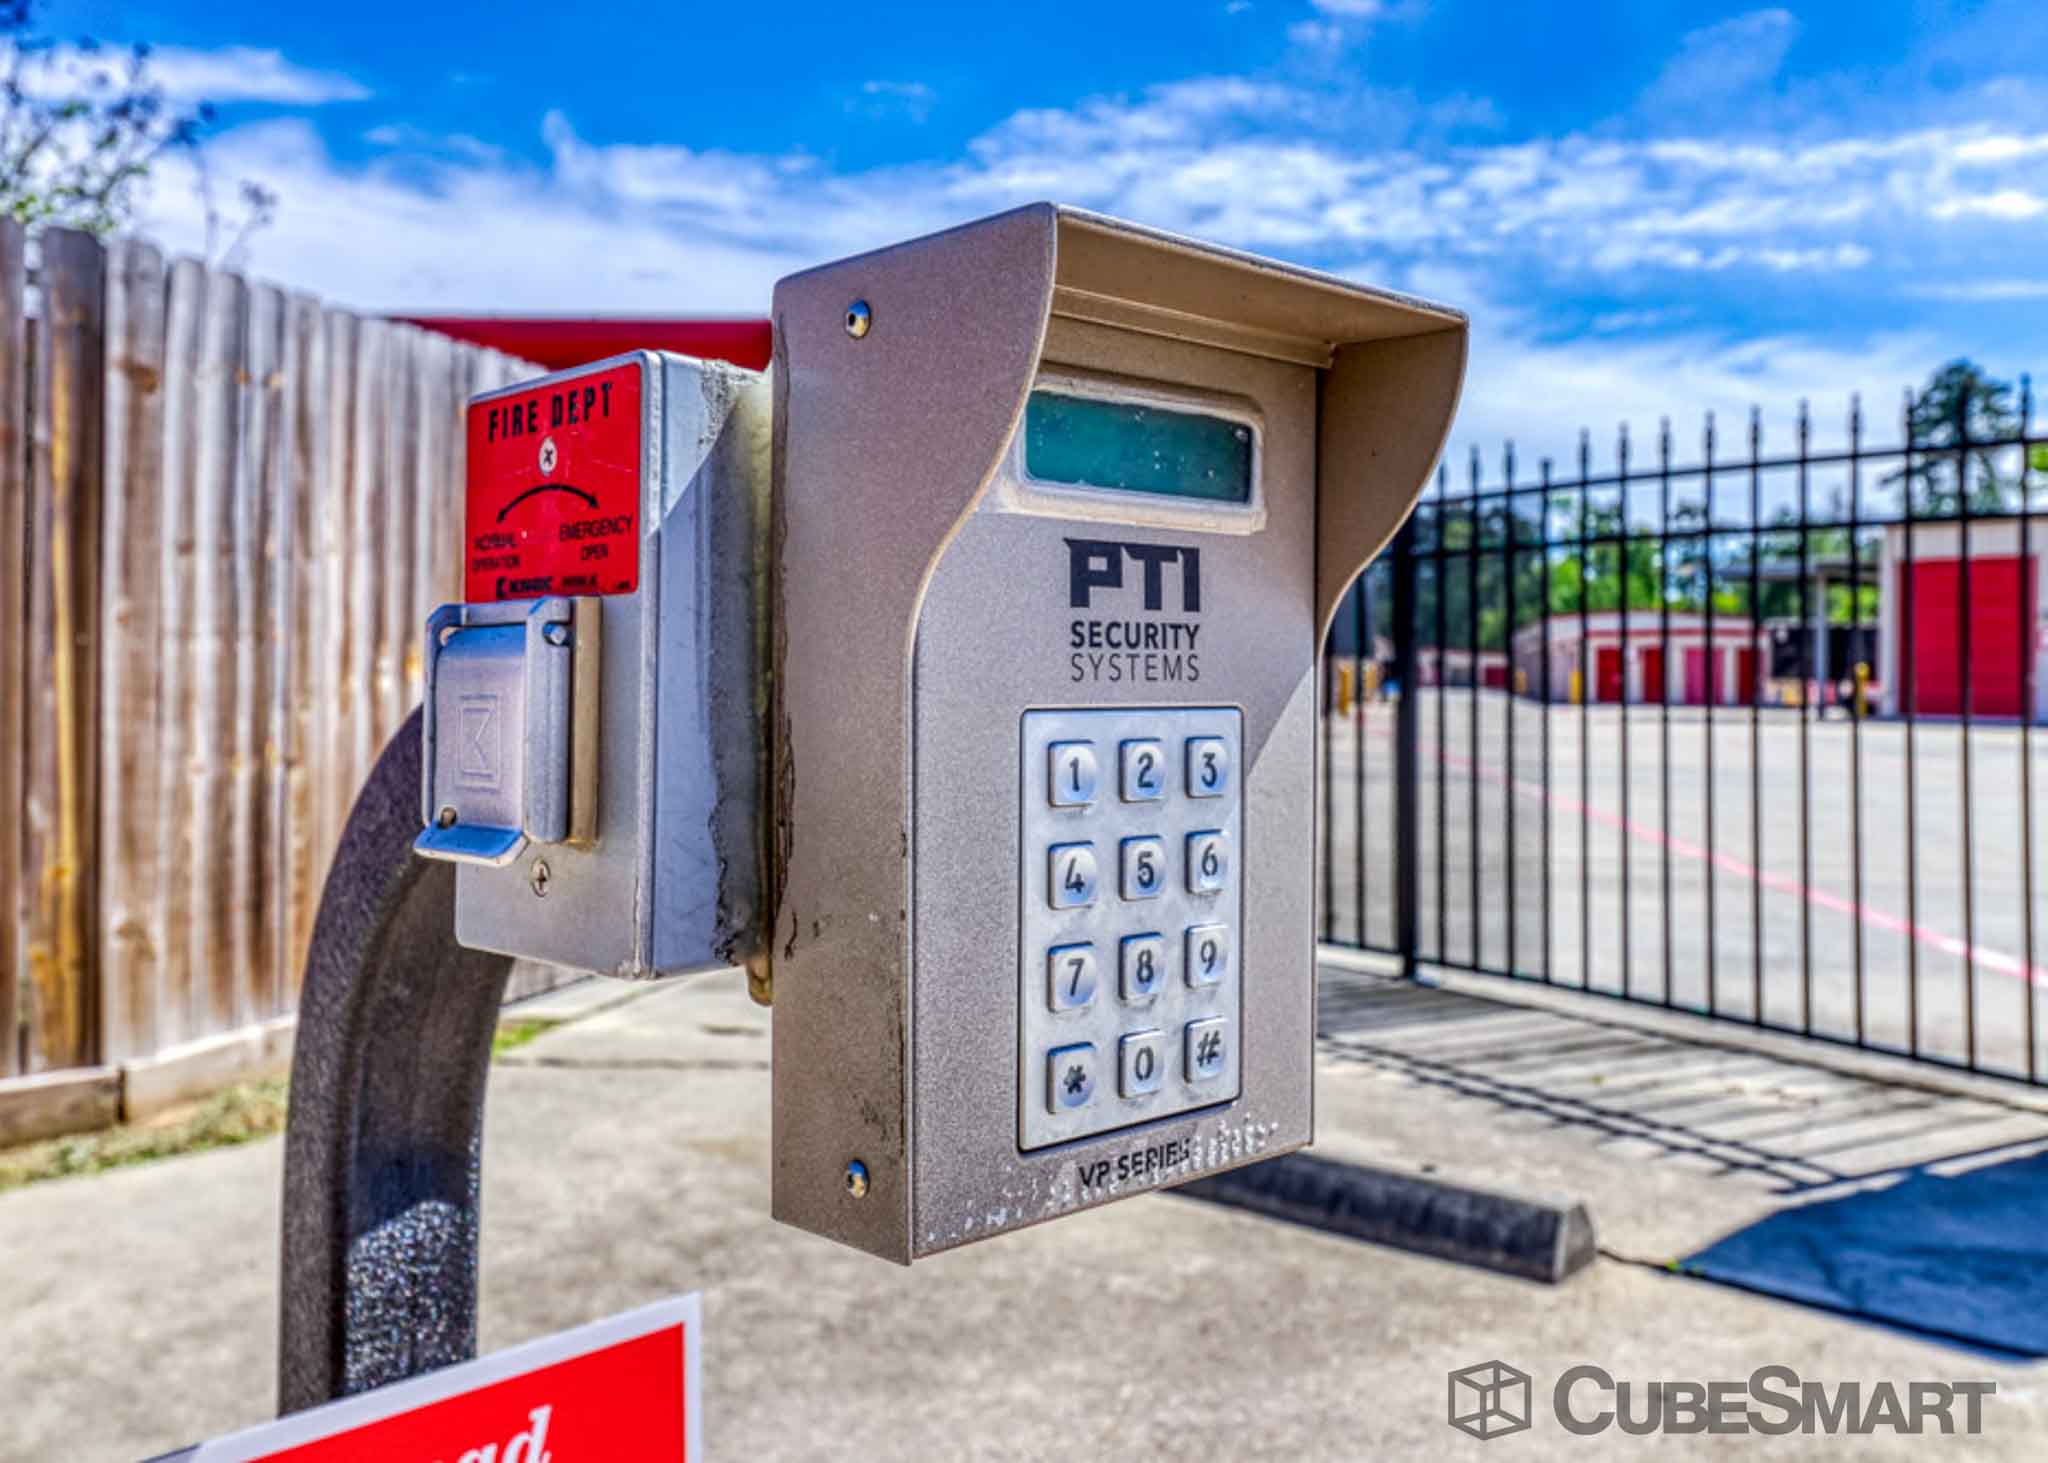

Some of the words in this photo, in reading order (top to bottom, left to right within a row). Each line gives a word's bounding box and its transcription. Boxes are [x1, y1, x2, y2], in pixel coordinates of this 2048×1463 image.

[488, 400, 539, 443] FIRE
[551, 381, 613, 429] DEPT
[559, 514, 633, 542] EMERGENCY
[1063, 537, 1200, 612] PTI
[1070, 620, 1200, 650] SECURITY
[1071, 653, 1200, 683] SYSTEMS
[1069, 757, 1080, 792] 1
[1137, 752, 1155, 789] 2
[1201, 752, 1218, 788] 3
[1065, 857, 1085, 893] 4
[1137, 851, 1154, 888] 5
[1202, 843, 1218, 877] 6
[1067, 958, 1085, 996] 7
[1136, 949, 1154, 984] 8
[1200, 940, 1217, 974] 9
[1135, 1047, 1154, 1081] 0
[1078, 1160, 1111, 1188] VP
[1118, 1137, 1190, 1181] SERIES
